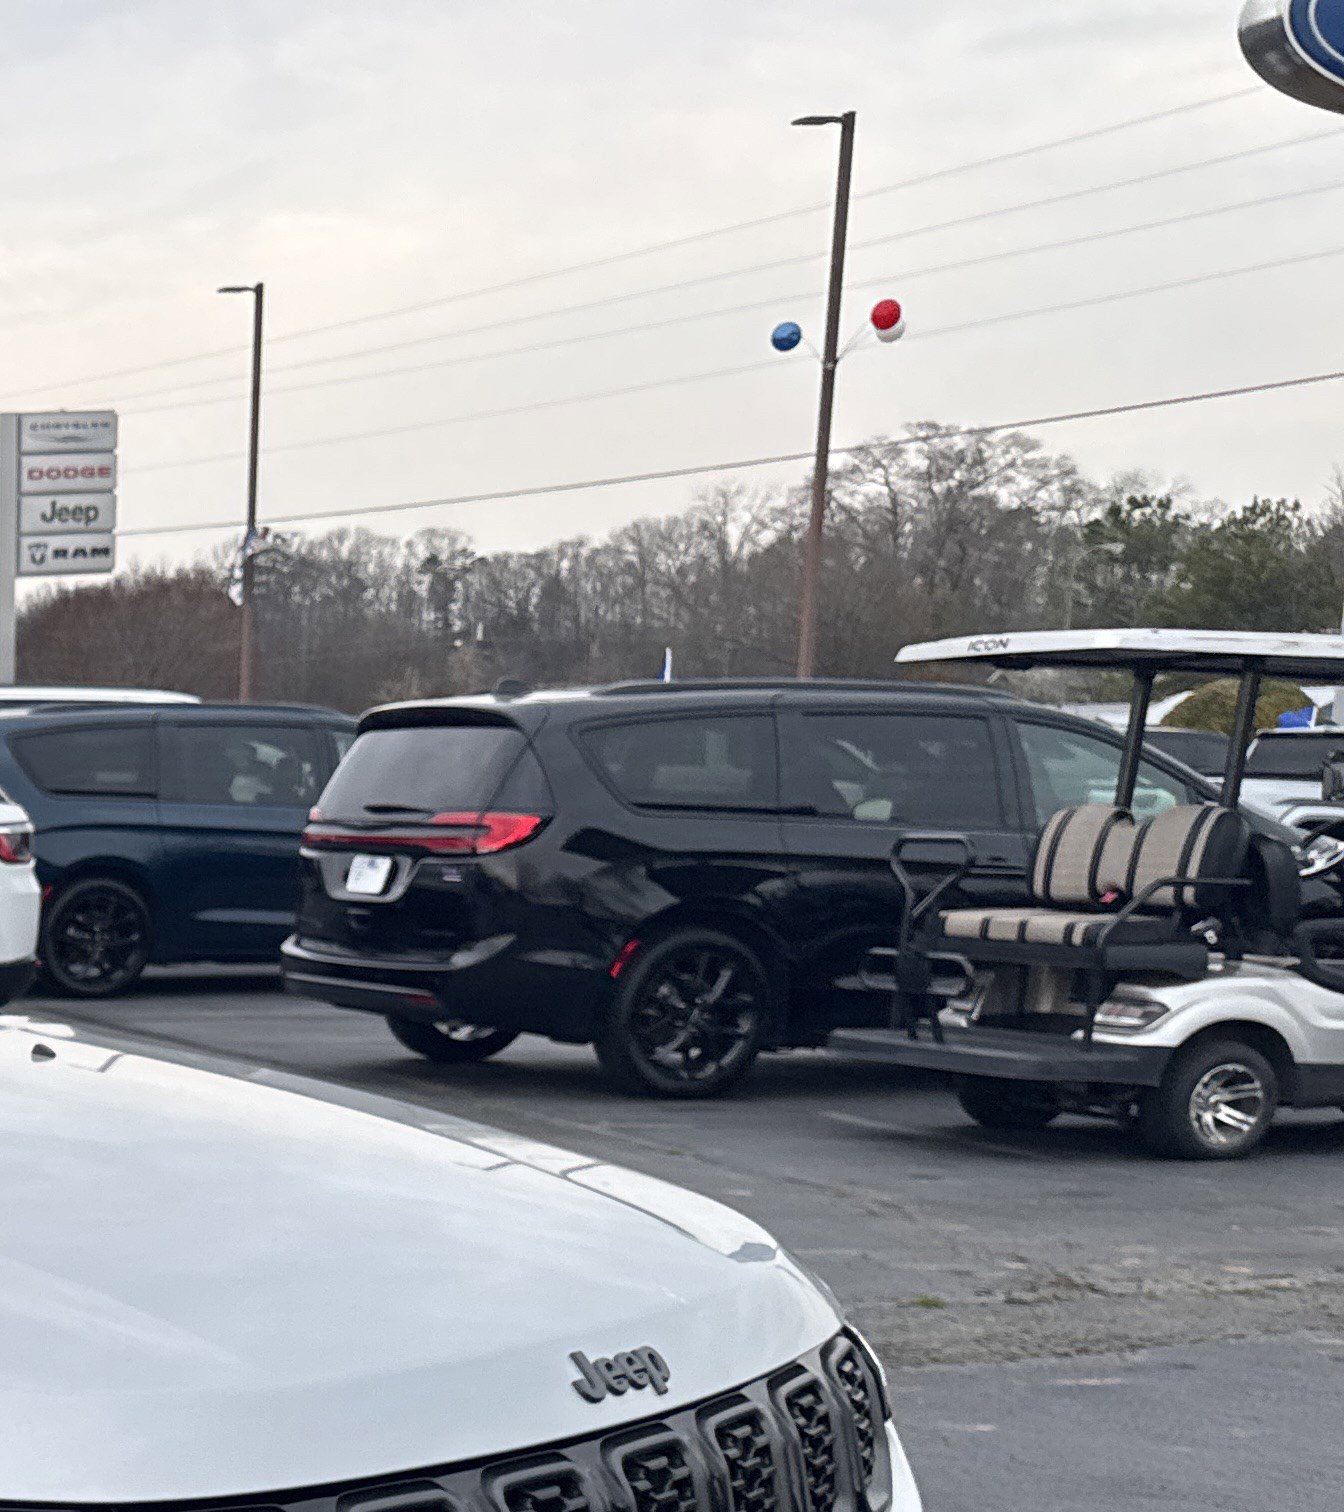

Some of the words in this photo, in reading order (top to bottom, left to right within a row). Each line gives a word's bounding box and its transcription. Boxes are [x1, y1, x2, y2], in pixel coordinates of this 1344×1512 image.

[27, 467, 112, 481] DODGE
[40, 500, 100, 526] Jeep
[52, 546, 110, 560] RAM
[967, 637, 1010, 652] ICON
[568, 1345, 671, 1404] Jeep
